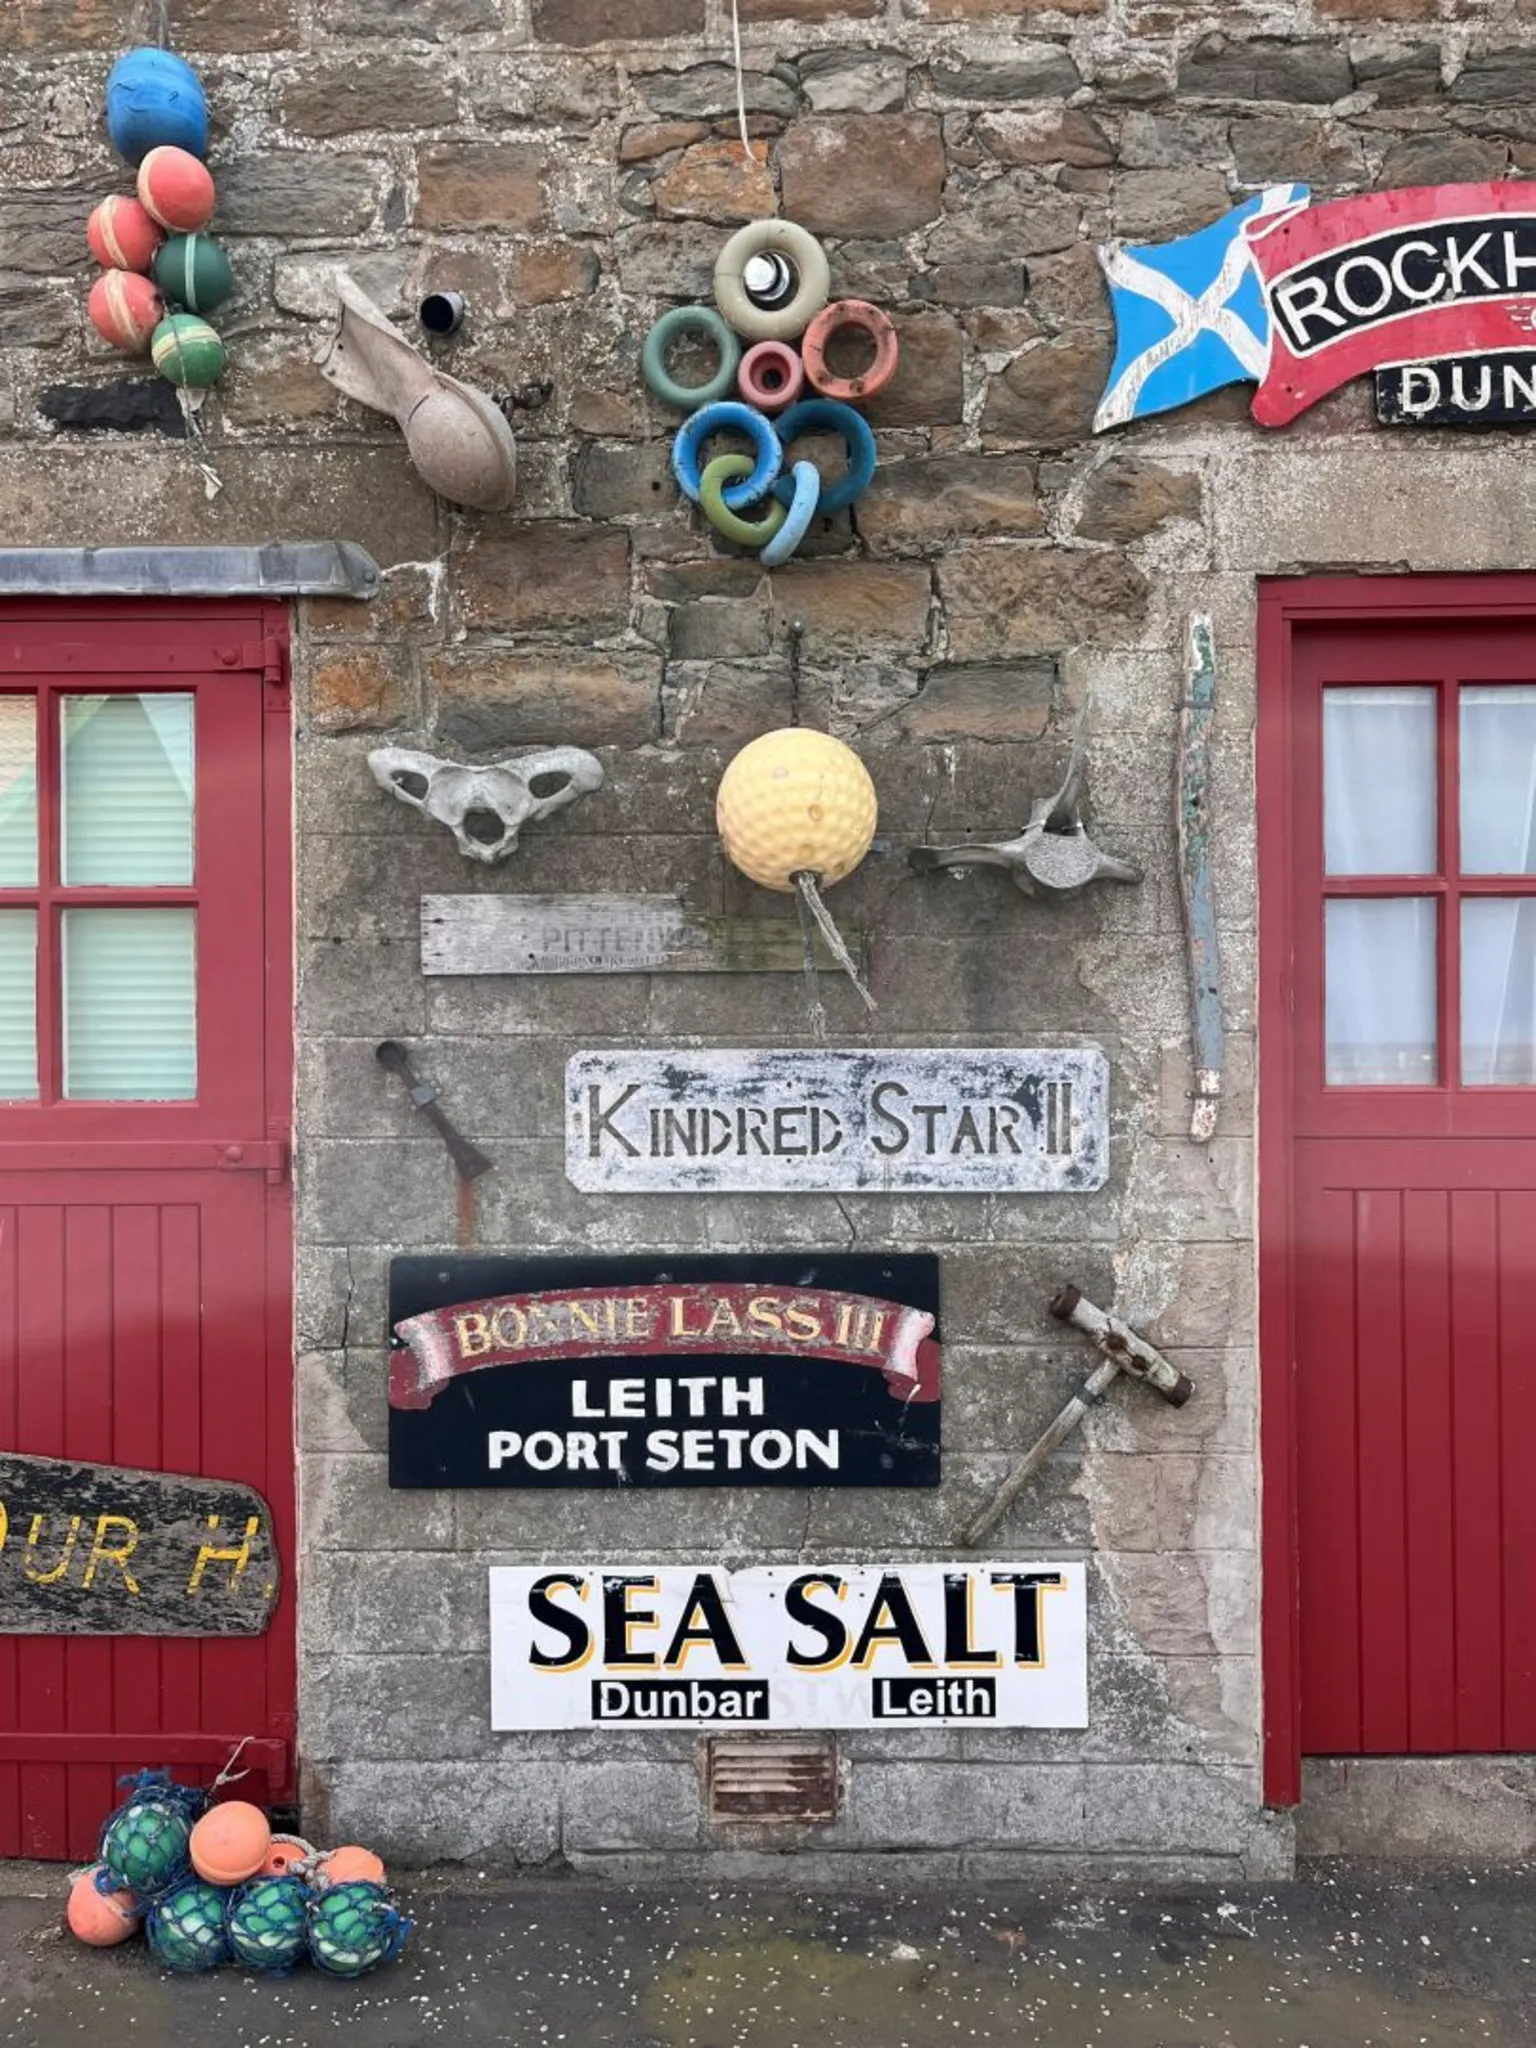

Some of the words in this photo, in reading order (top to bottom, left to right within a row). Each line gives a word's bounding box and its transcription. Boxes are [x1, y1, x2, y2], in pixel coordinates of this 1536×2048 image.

[1400, 363, 1536, 412] DUN
[588, 1083, 843, 1158] KINDRED
[871, 1081, 1022, 1156] STAR
[1044, 1082, 1075, 1155] II
[456, 1297, 652, 1358] BONNIE
[668, 1295, 822, 1342] LASS
[834, 1304, 886, 1352] III
[571, 1376, 765, 1418] LEITH
[488, 1430, 628, 1470] PORT
[645, 1429, 840, 1472] SETON
[0, 1500, 141, 1596] UR
[527, 1572, 753, 1671] SEA
[784, 1571, 1068, 1671] SALT
[600, 1679, 764, 1718] Dunbar
[881, 1678, 993, 1716] Leith
